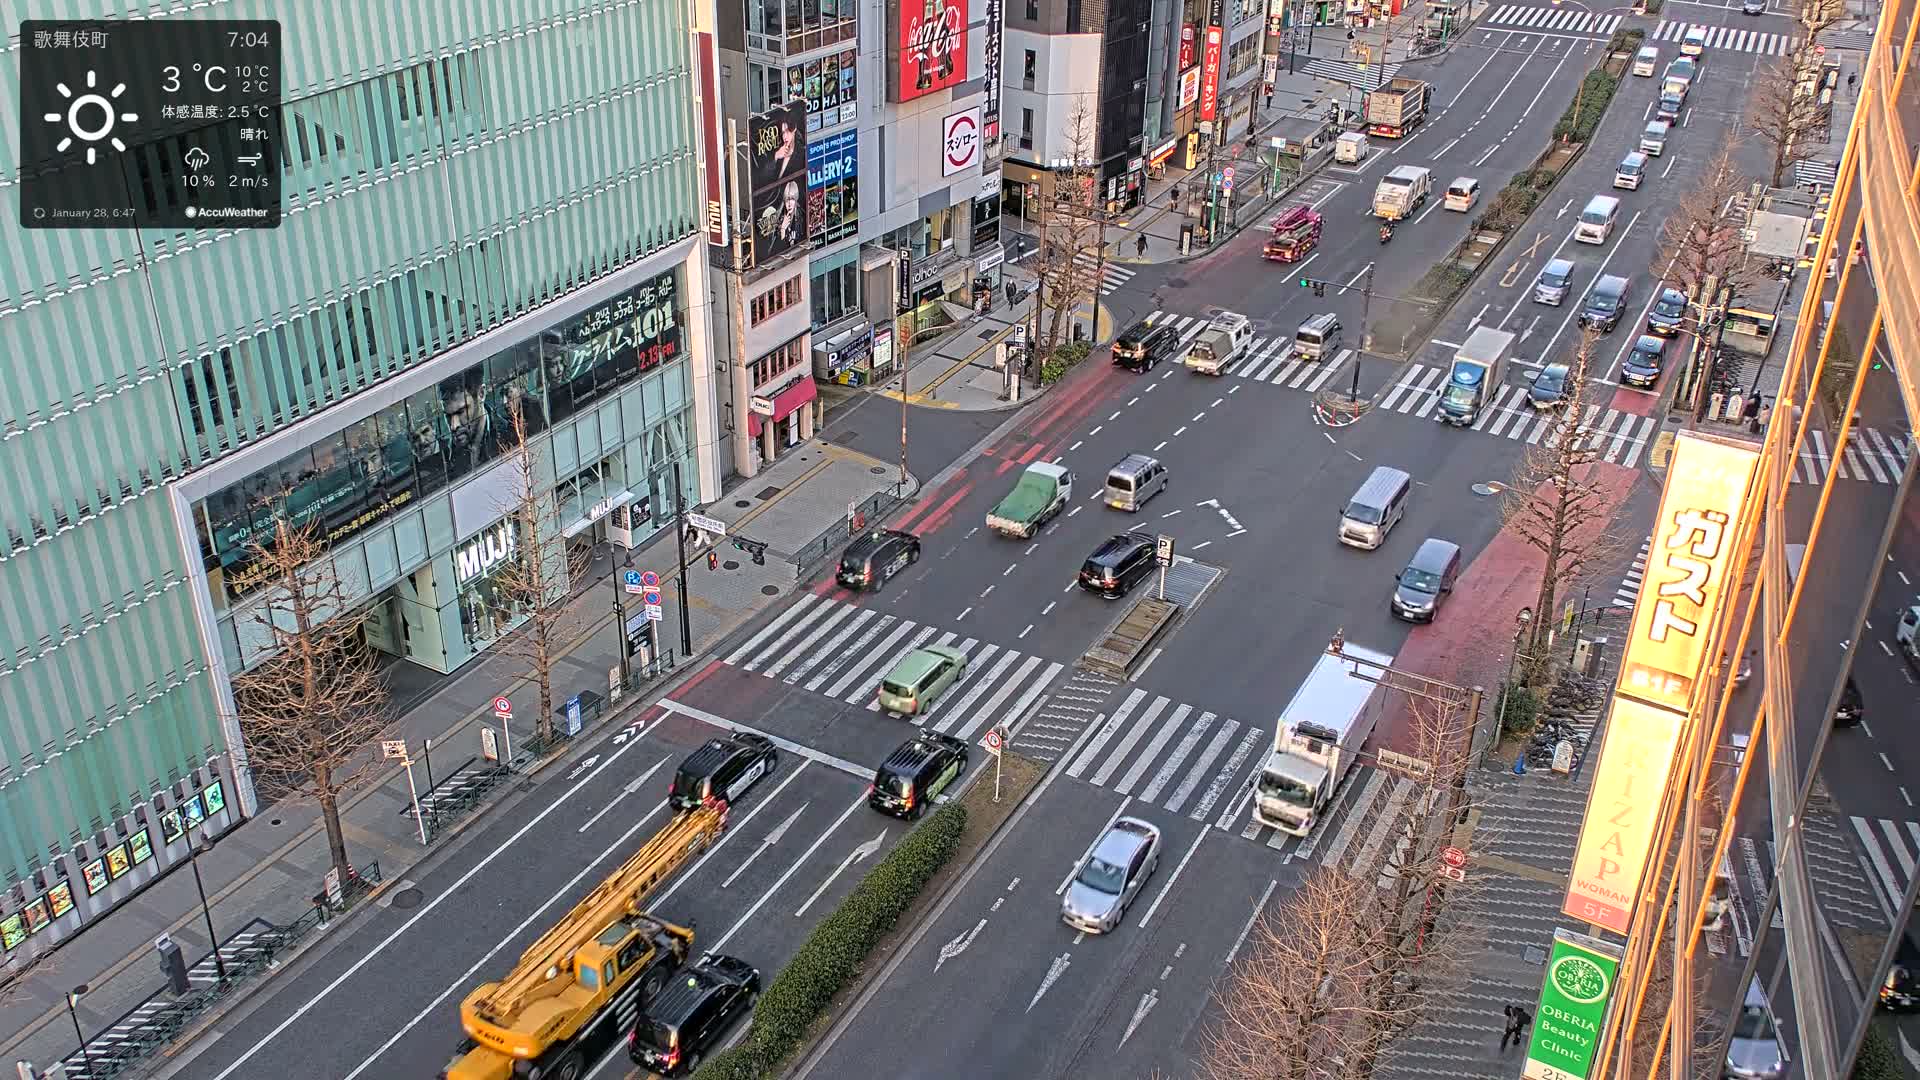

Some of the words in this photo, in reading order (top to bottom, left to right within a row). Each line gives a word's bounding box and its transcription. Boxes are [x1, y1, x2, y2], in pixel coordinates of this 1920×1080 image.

[1203, 46, 1219, 112] バーガーキング
[809, 143, 830, 155] SPORTS
[842, 133, 855, 144] SHOP
[946, 133, 978, 154] スシロー
[709, 200, 721, 233] MUJI
[901, 250, 908, 260] P
[595, 307, 609, 320] クリス
[1016, 327, 1024, 335] P
[640, 345, 658, 370] 2.13
[662, 341, 675, 357] FRI
[829, 352, 838, 367] P
[590, 497, 613, 520] MUJI
[458, 522, 514, 582] MUJI
[1160, 540, 1167, 549] P
[628, 573, 635, 581] P
[1648, 508, 1729, 643] ガスト
[1576, 880, 1630, 904] WOMAN
[1583, 902, 1611, 920] 5F
[1558, 970, 1599, 991] OBERIA
[1542, 1005, 1596, 1032] OBERIA
[1542, 1020, 1590, 1046] Beauty
[1541, 1040, 1583, 1062] Clinic
